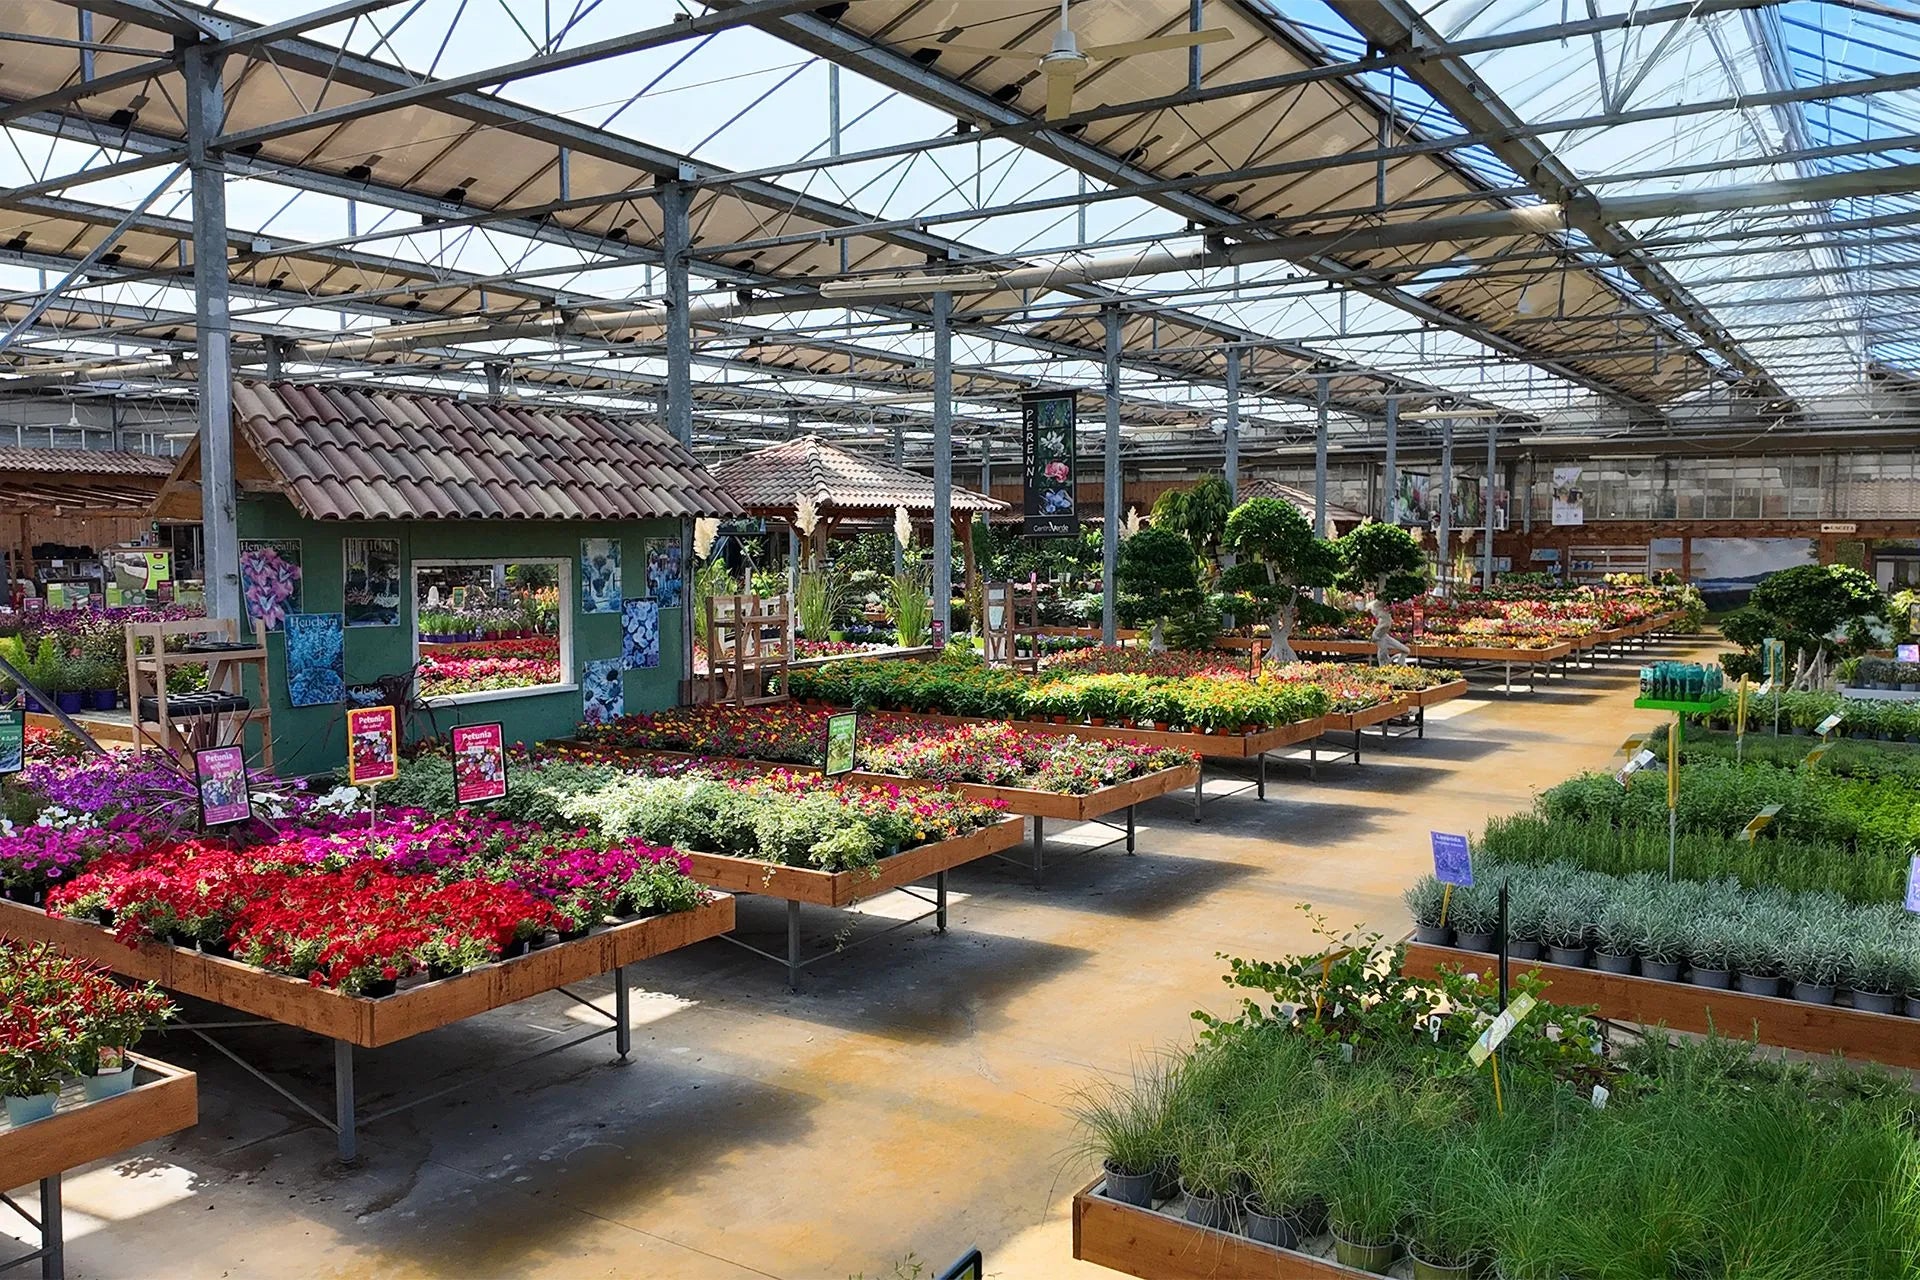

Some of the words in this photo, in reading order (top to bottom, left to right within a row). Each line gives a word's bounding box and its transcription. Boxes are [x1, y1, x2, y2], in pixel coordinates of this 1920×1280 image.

[1026, 409, 1035, 488] PERENNI
[358, 714, 385, 724] Petunia
[462, 730, 492, 741] Petunia
[204, 751, 234, 763] Petunia
